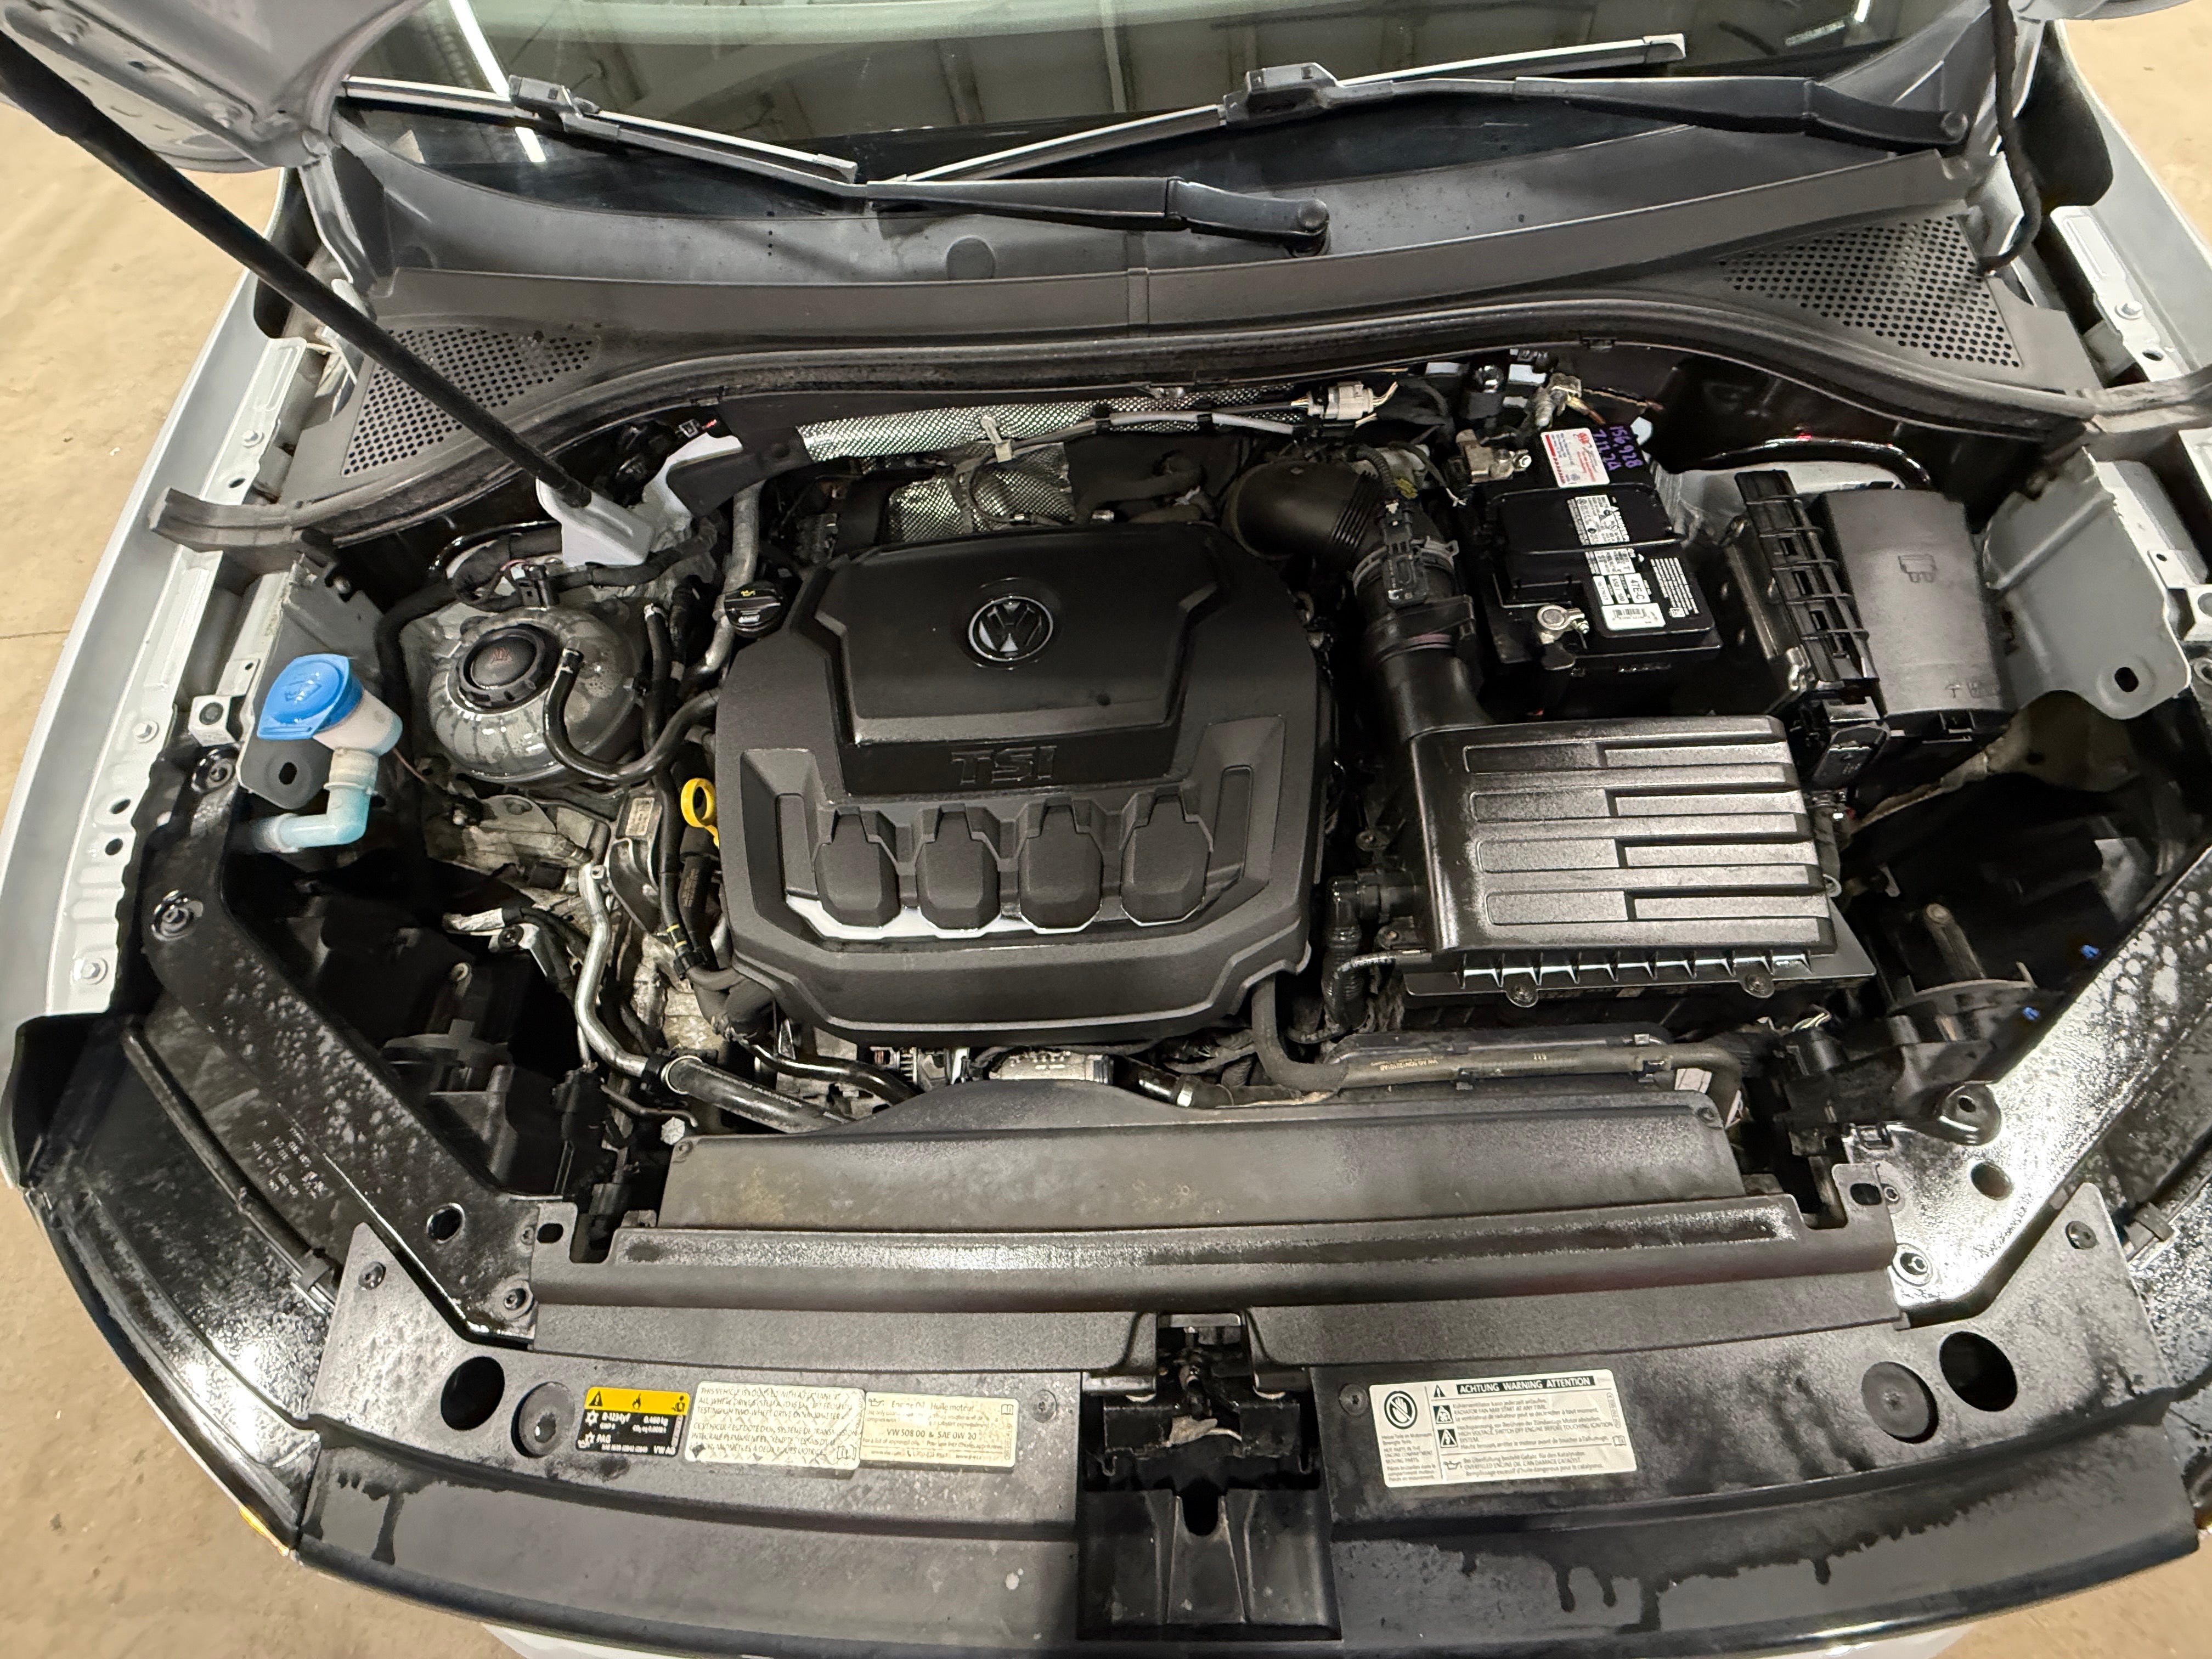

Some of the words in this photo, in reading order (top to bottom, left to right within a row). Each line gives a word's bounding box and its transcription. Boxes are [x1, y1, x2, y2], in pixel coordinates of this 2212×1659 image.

[1630, 579, 1645, 600] 47E-C
[951, 746, 1057, 784] TSI
[1460, 1383, 1500, 1393] ACHTUNG
[1502, 1379, 1543, 1391] WARNING
[1546, 1377, 1591, 1388] ATTENTION
[887, 1428, 900, 1436] VW
[901, 1429, 915, 1437] 508
